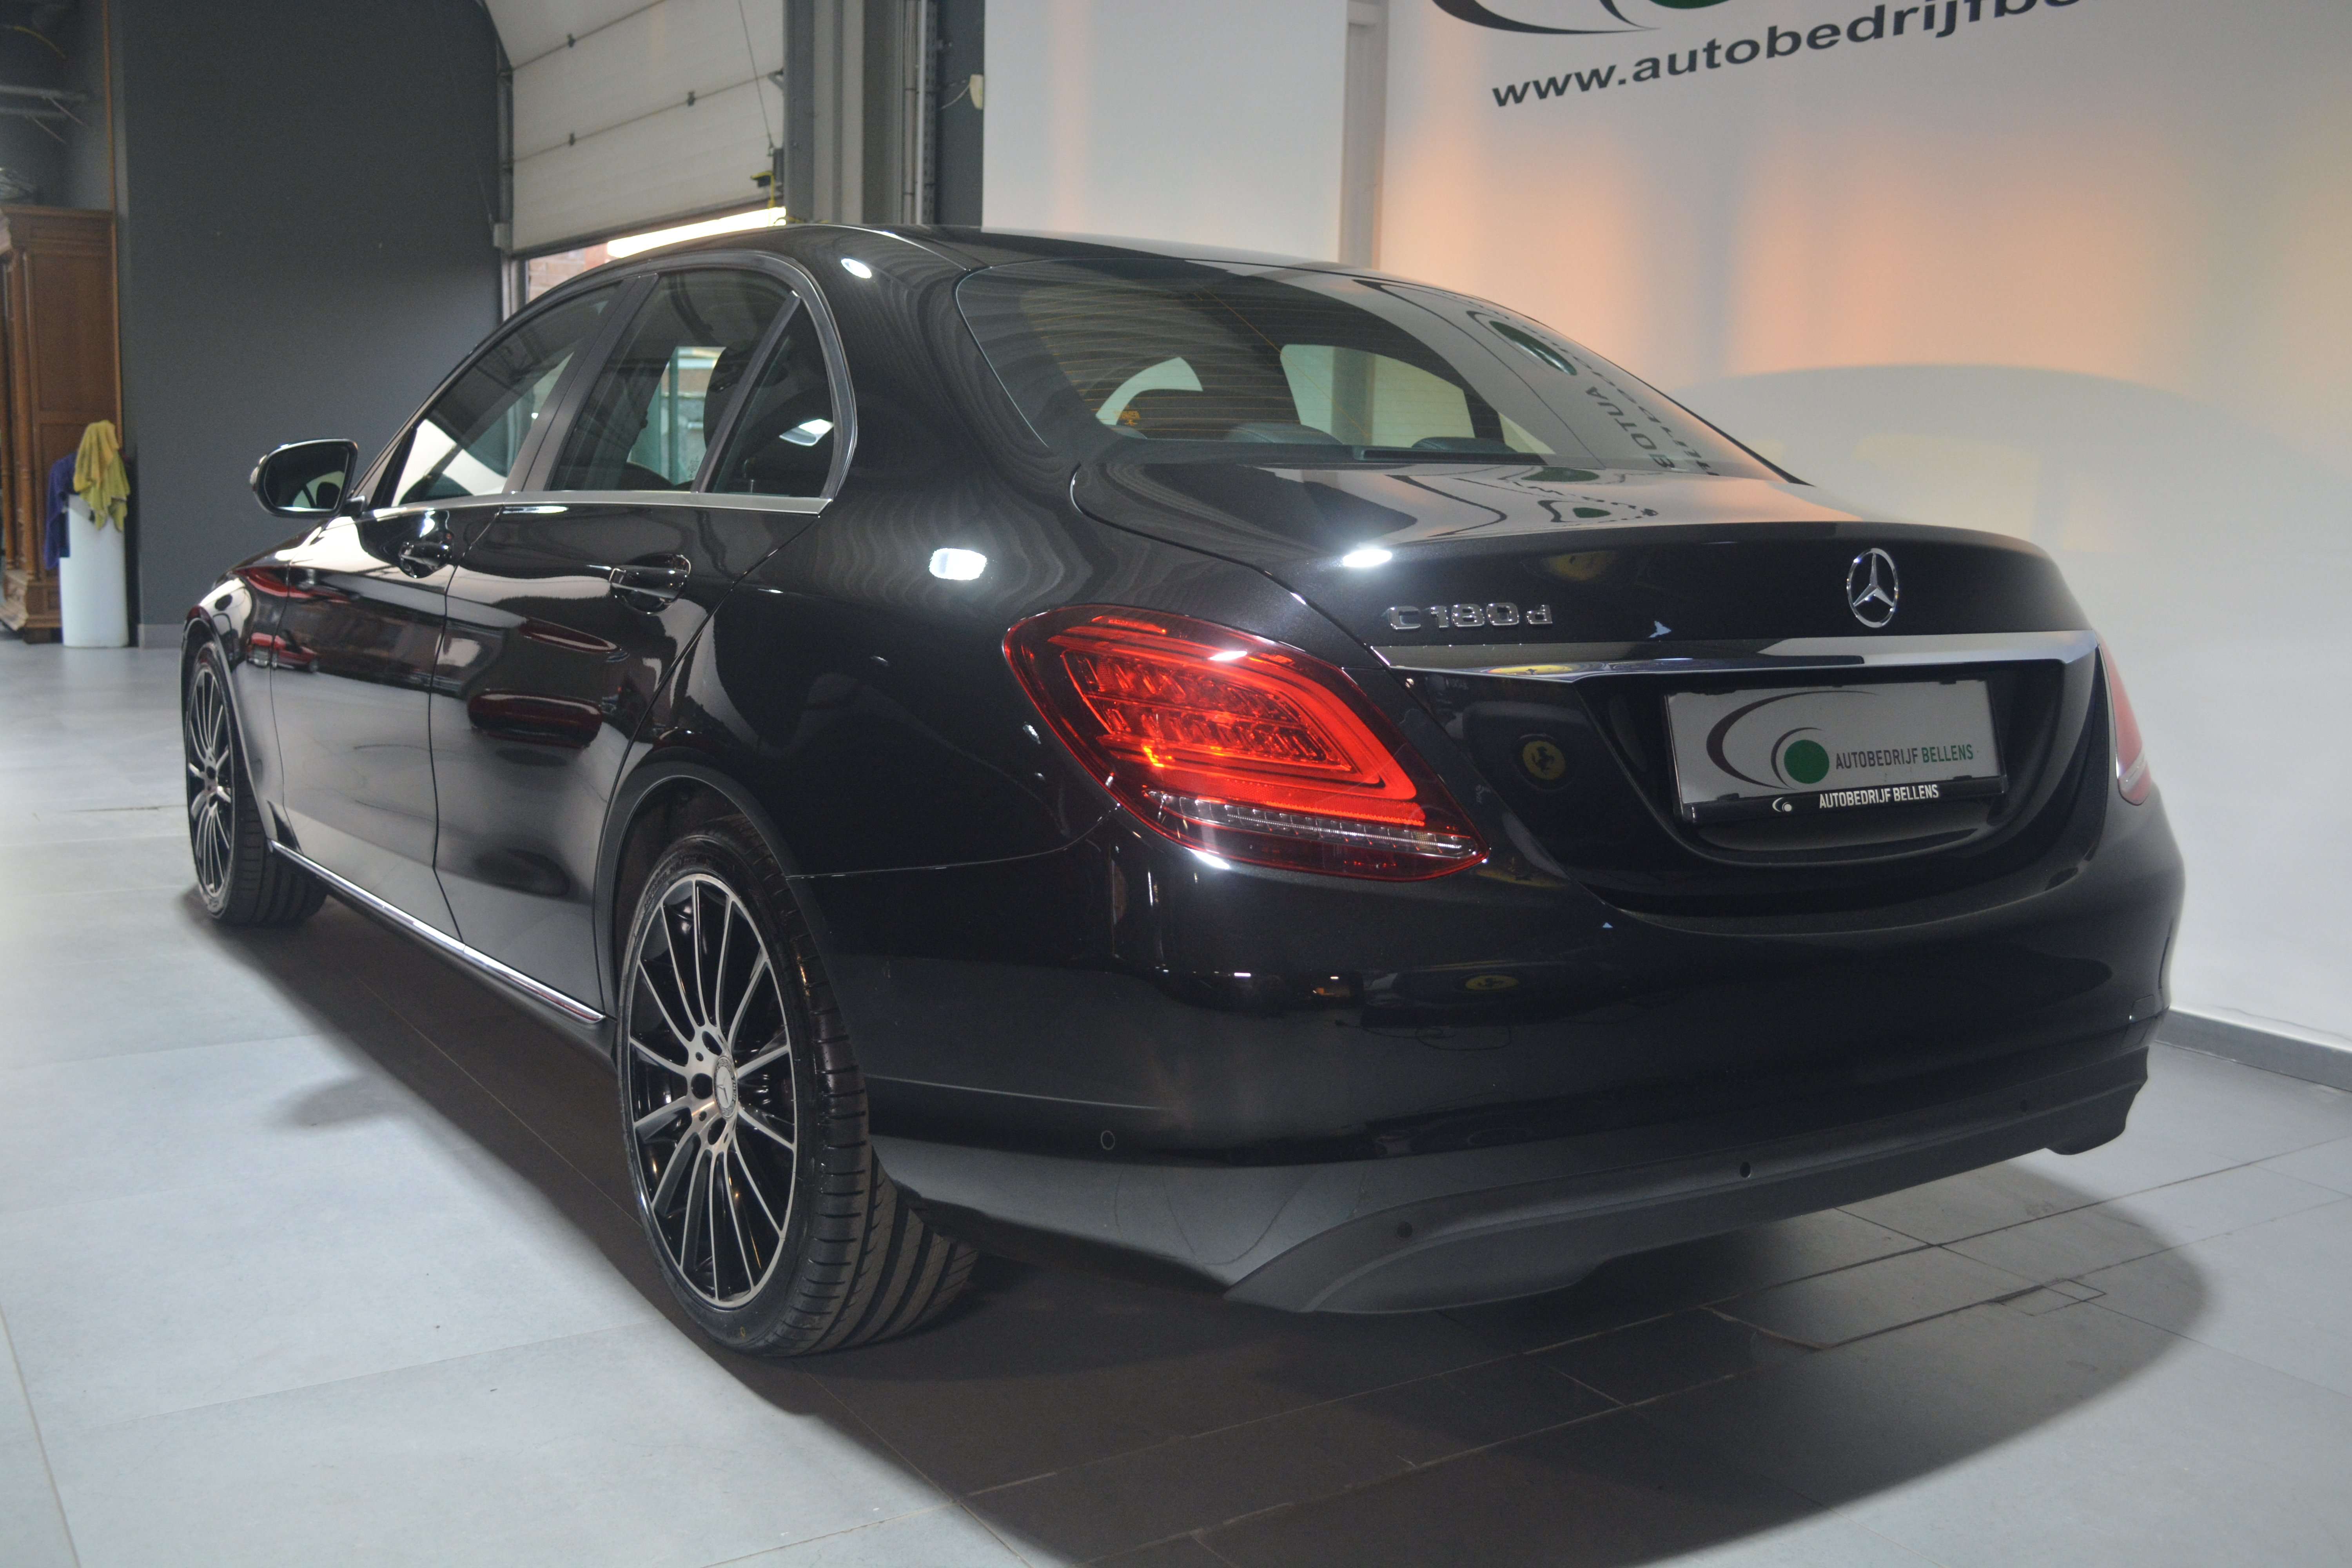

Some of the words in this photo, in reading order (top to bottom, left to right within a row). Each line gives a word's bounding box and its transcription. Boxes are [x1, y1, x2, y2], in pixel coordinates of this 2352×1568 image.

[1492, 0, 2079, 107] www.autobedrijf
[1430, 602, 1520, 628] 180
[1836, 748, 1918, 769] AUTOBEDRIJF
[1922, 744, 1973, 763] BELLENS
[1819, 788, 1891, 809] AUTOBEDRIJF
[1893, 784, 1939, 801] BELLENS
